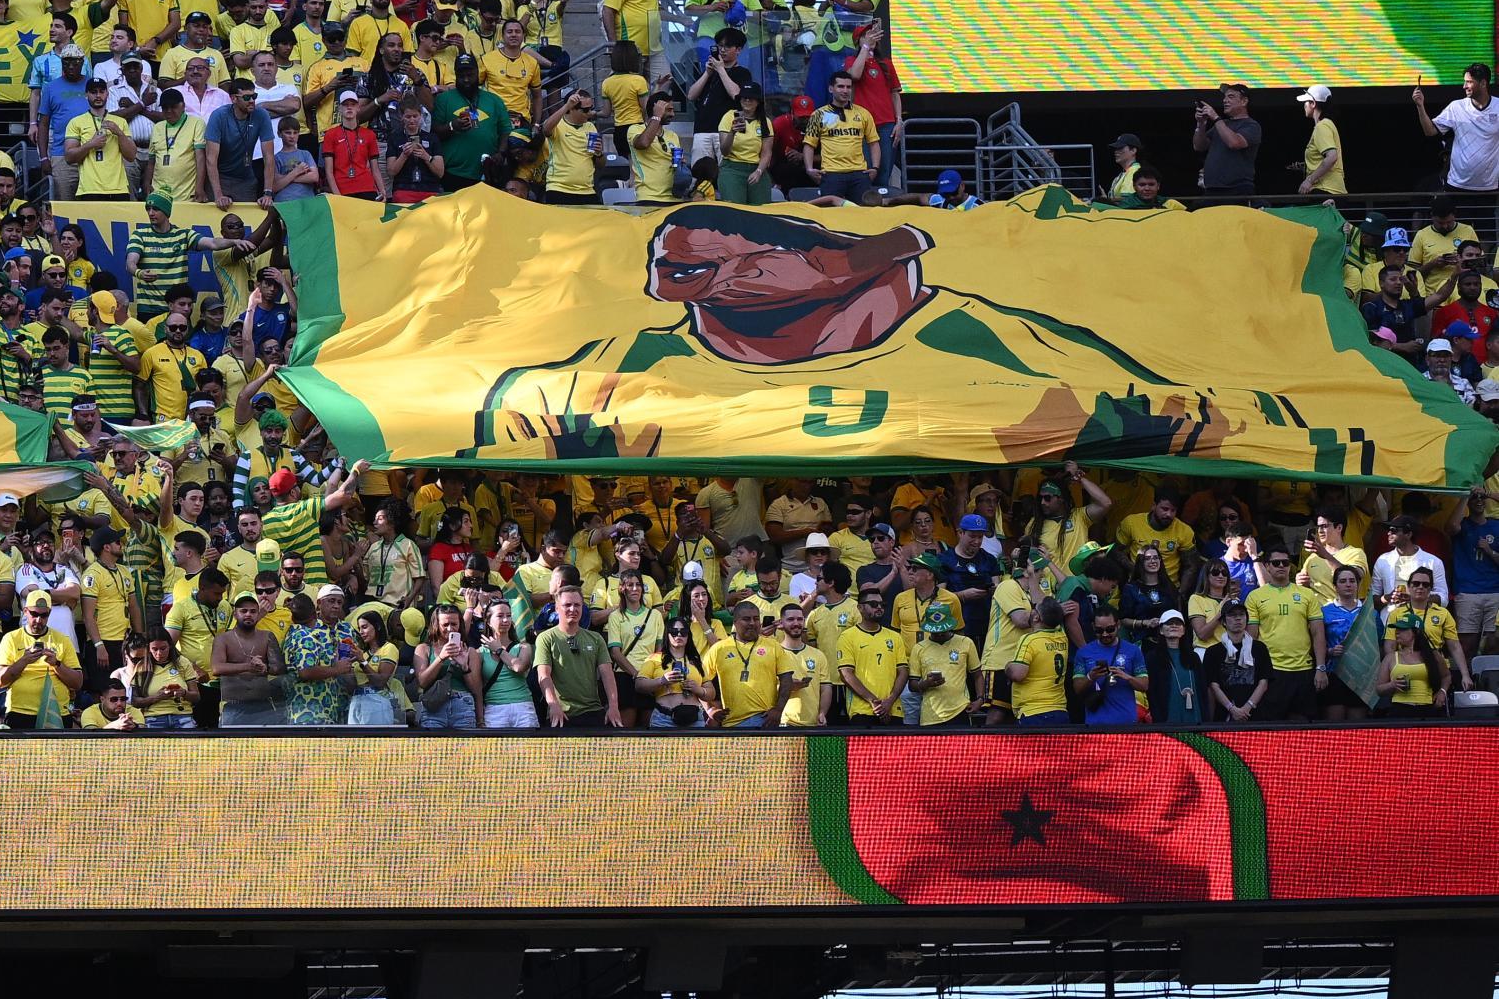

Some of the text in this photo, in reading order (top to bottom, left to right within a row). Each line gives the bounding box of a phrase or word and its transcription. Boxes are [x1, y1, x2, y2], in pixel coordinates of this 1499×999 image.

[1278, 603, 1289, 616] 10
[923, 622, 953, 633] BRAZIL
[876, 653, 882, 665] 7
[1053, 653, 1065, 685] 9
